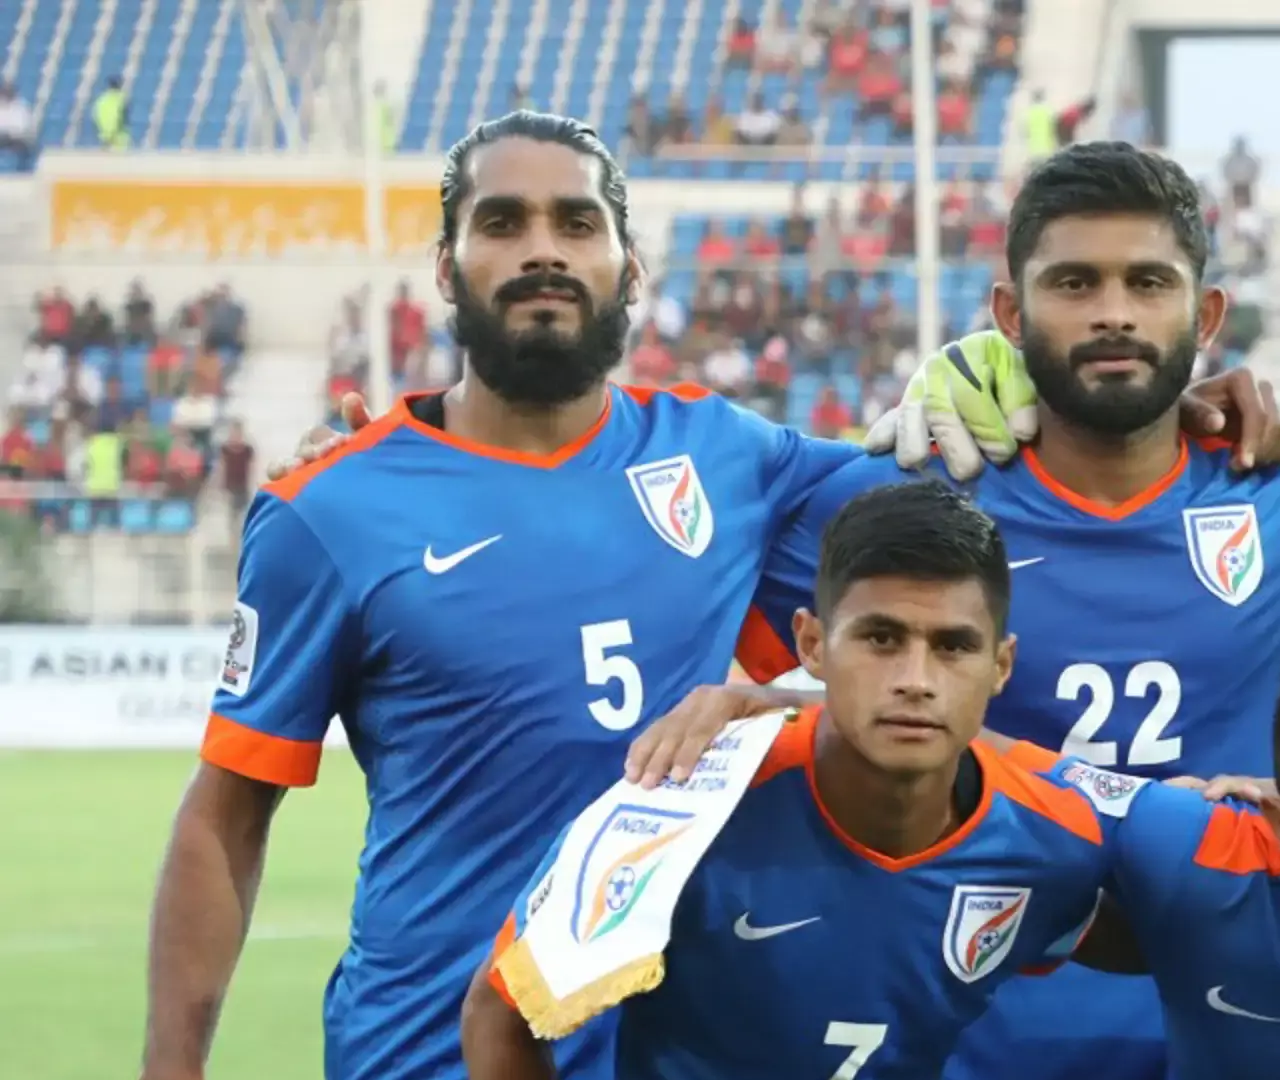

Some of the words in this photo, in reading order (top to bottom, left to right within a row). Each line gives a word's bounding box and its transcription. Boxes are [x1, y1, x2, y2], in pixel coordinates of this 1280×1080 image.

[1199, 519, 1236, 532] INDIA
[30, 648, 168, 680] ASIAN
[582, 619, 643, 731] 5
[1055, 660, 1183, 767] 22
[611, 817, 661, 835] INDIA
[967, 899, 1004, 911] INDIA
